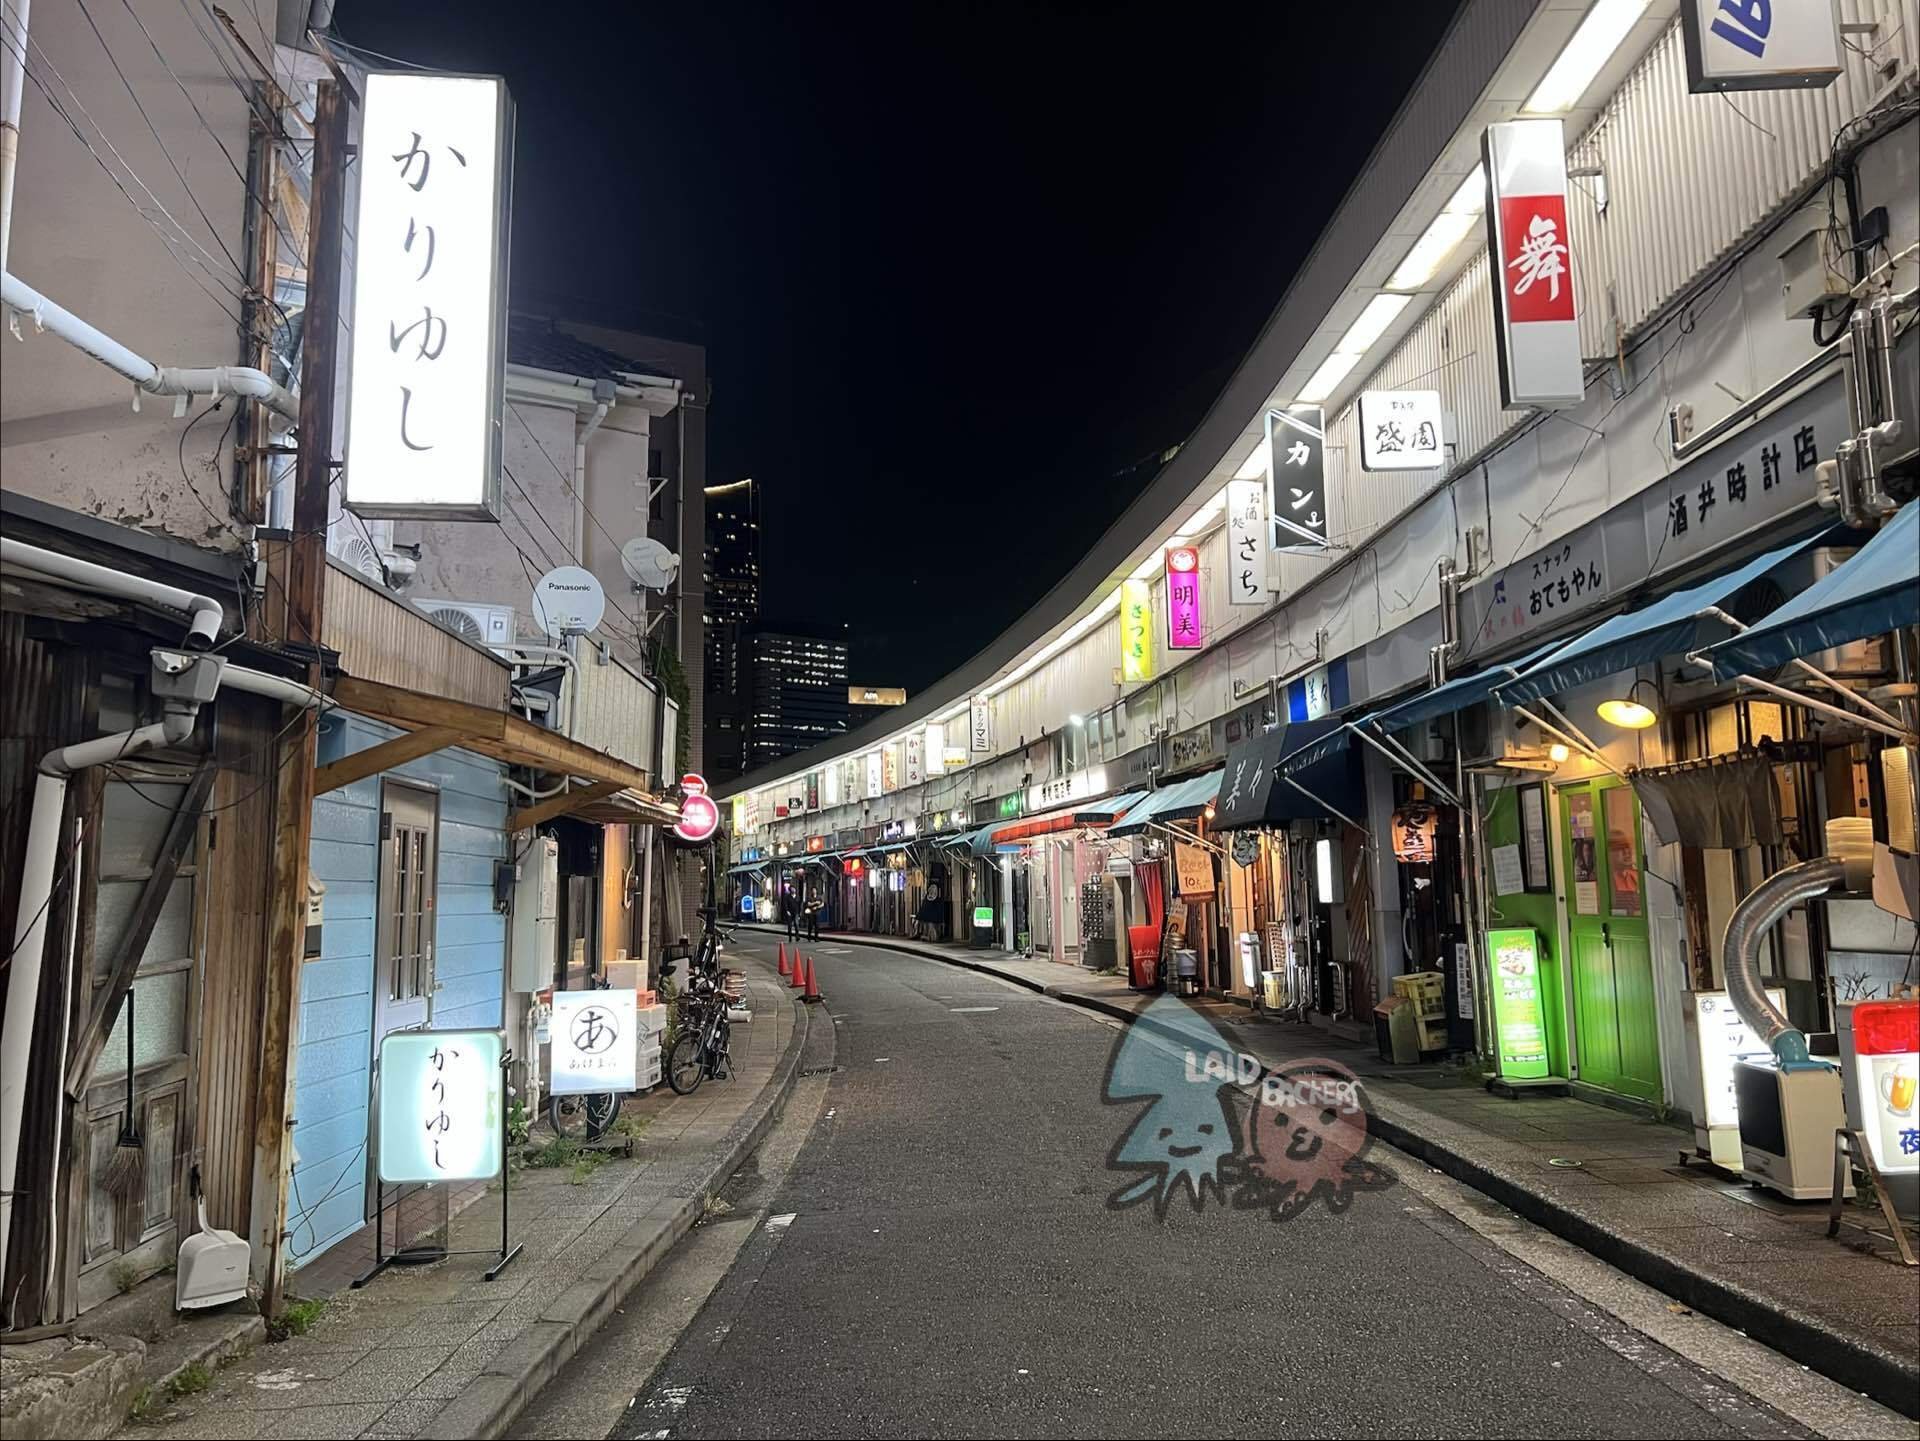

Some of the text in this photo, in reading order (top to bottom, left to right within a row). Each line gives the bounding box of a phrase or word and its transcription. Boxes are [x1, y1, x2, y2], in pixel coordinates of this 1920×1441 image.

[1507, 214, 1568, 301] 舞
[391, 131, 467, 451] かりゆし
[1285, 440, 1314, 509] カン
[1668, 424, 1818, 538] 酒井時計店
[548, 582, 591, 592] Panasonic
[1238, 535, 1259, 597] さち
[1529, 560, 1602, 617] おてもやん
[1532, 543, 1571, 578] スナック
[1130, 604, 1146, 658] さつき
[1174, 585, 1195, 636] 明美
[574, 1010, 618, 1051] あ
[425, 1046, 460, 1170] かりゆし
